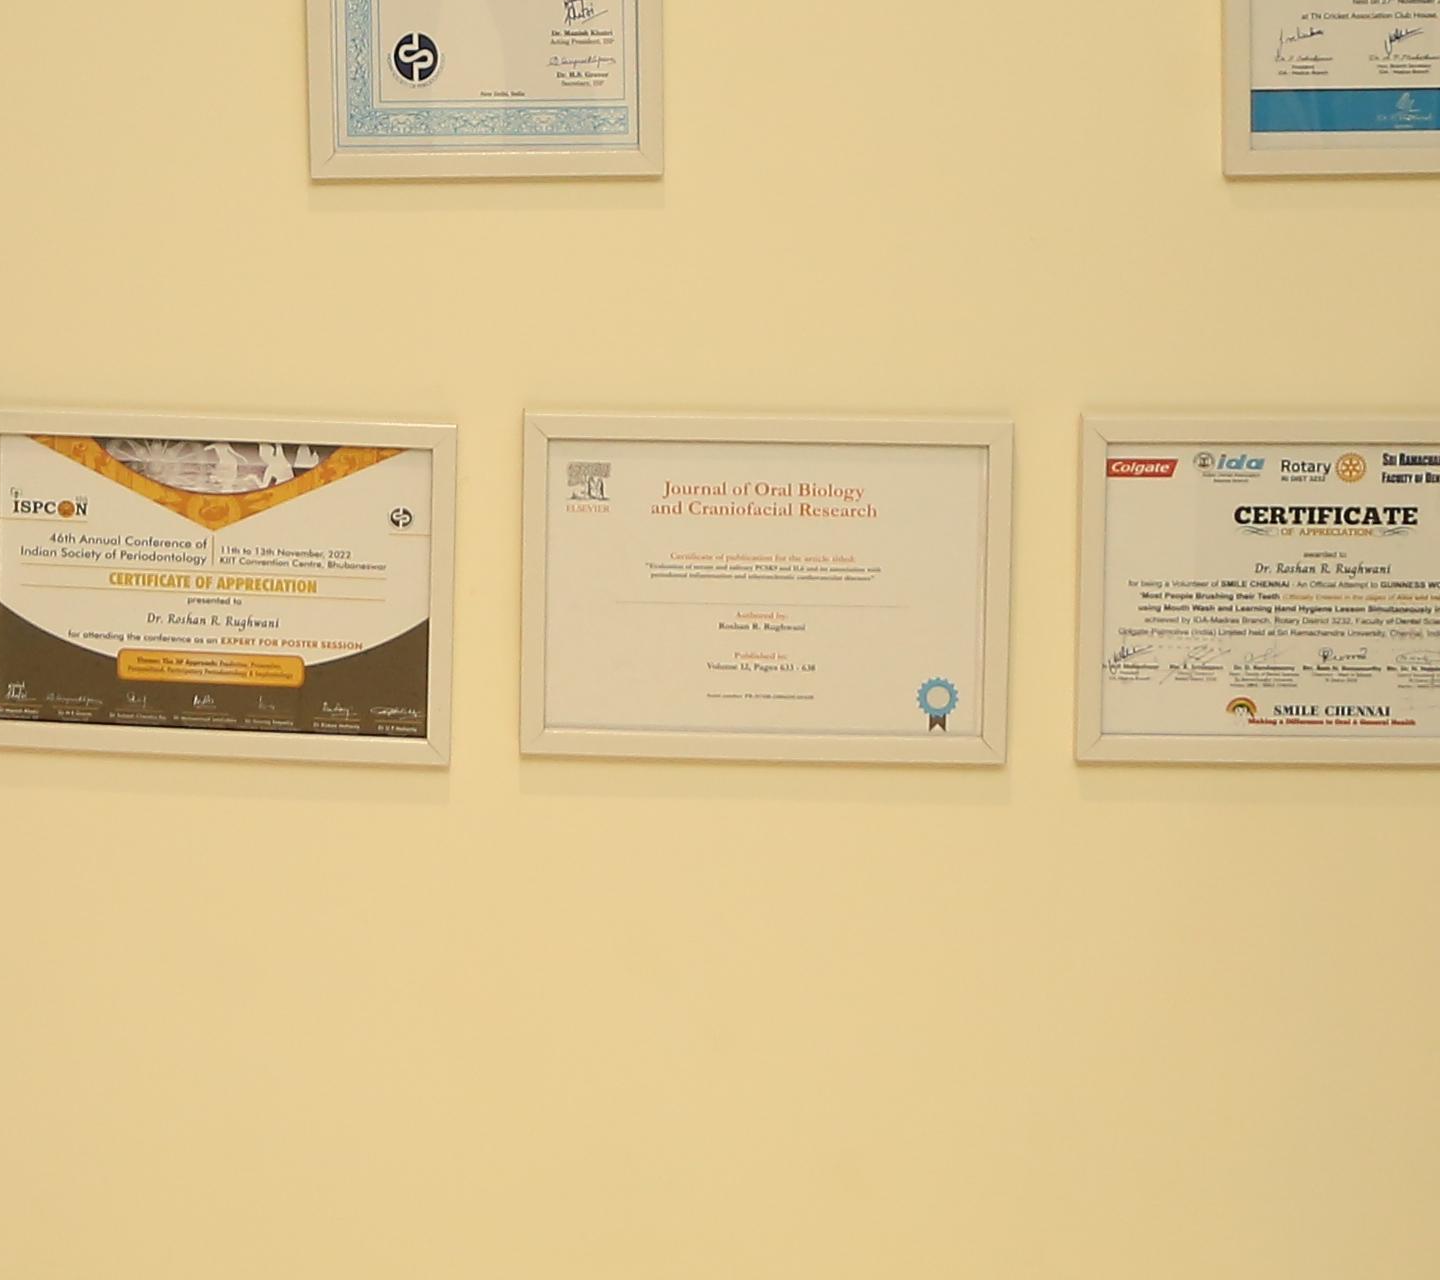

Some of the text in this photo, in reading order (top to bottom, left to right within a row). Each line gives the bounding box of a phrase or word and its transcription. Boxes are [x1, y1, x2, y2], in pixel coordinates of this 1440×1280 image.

[1111, 461, 1169, 475] Colgate
[1281, 459, 1331, 477] Rotary
[662, 481, 865, 501] Journal of Oral Biology
[651, 501, 877, 518] and Craniofacial Research
[1234, 506, 1417, 525] CERTIFICATE
[50, 533, 207, 549] 46th Annual Conference of
[20, 545, 207, 566] Indian Society of Periodontology
[109, 572, 317, 593] CERTIFICATE OF APPRECIATION
[1273, 706, 1390, 717] SMILE CHENNAI
